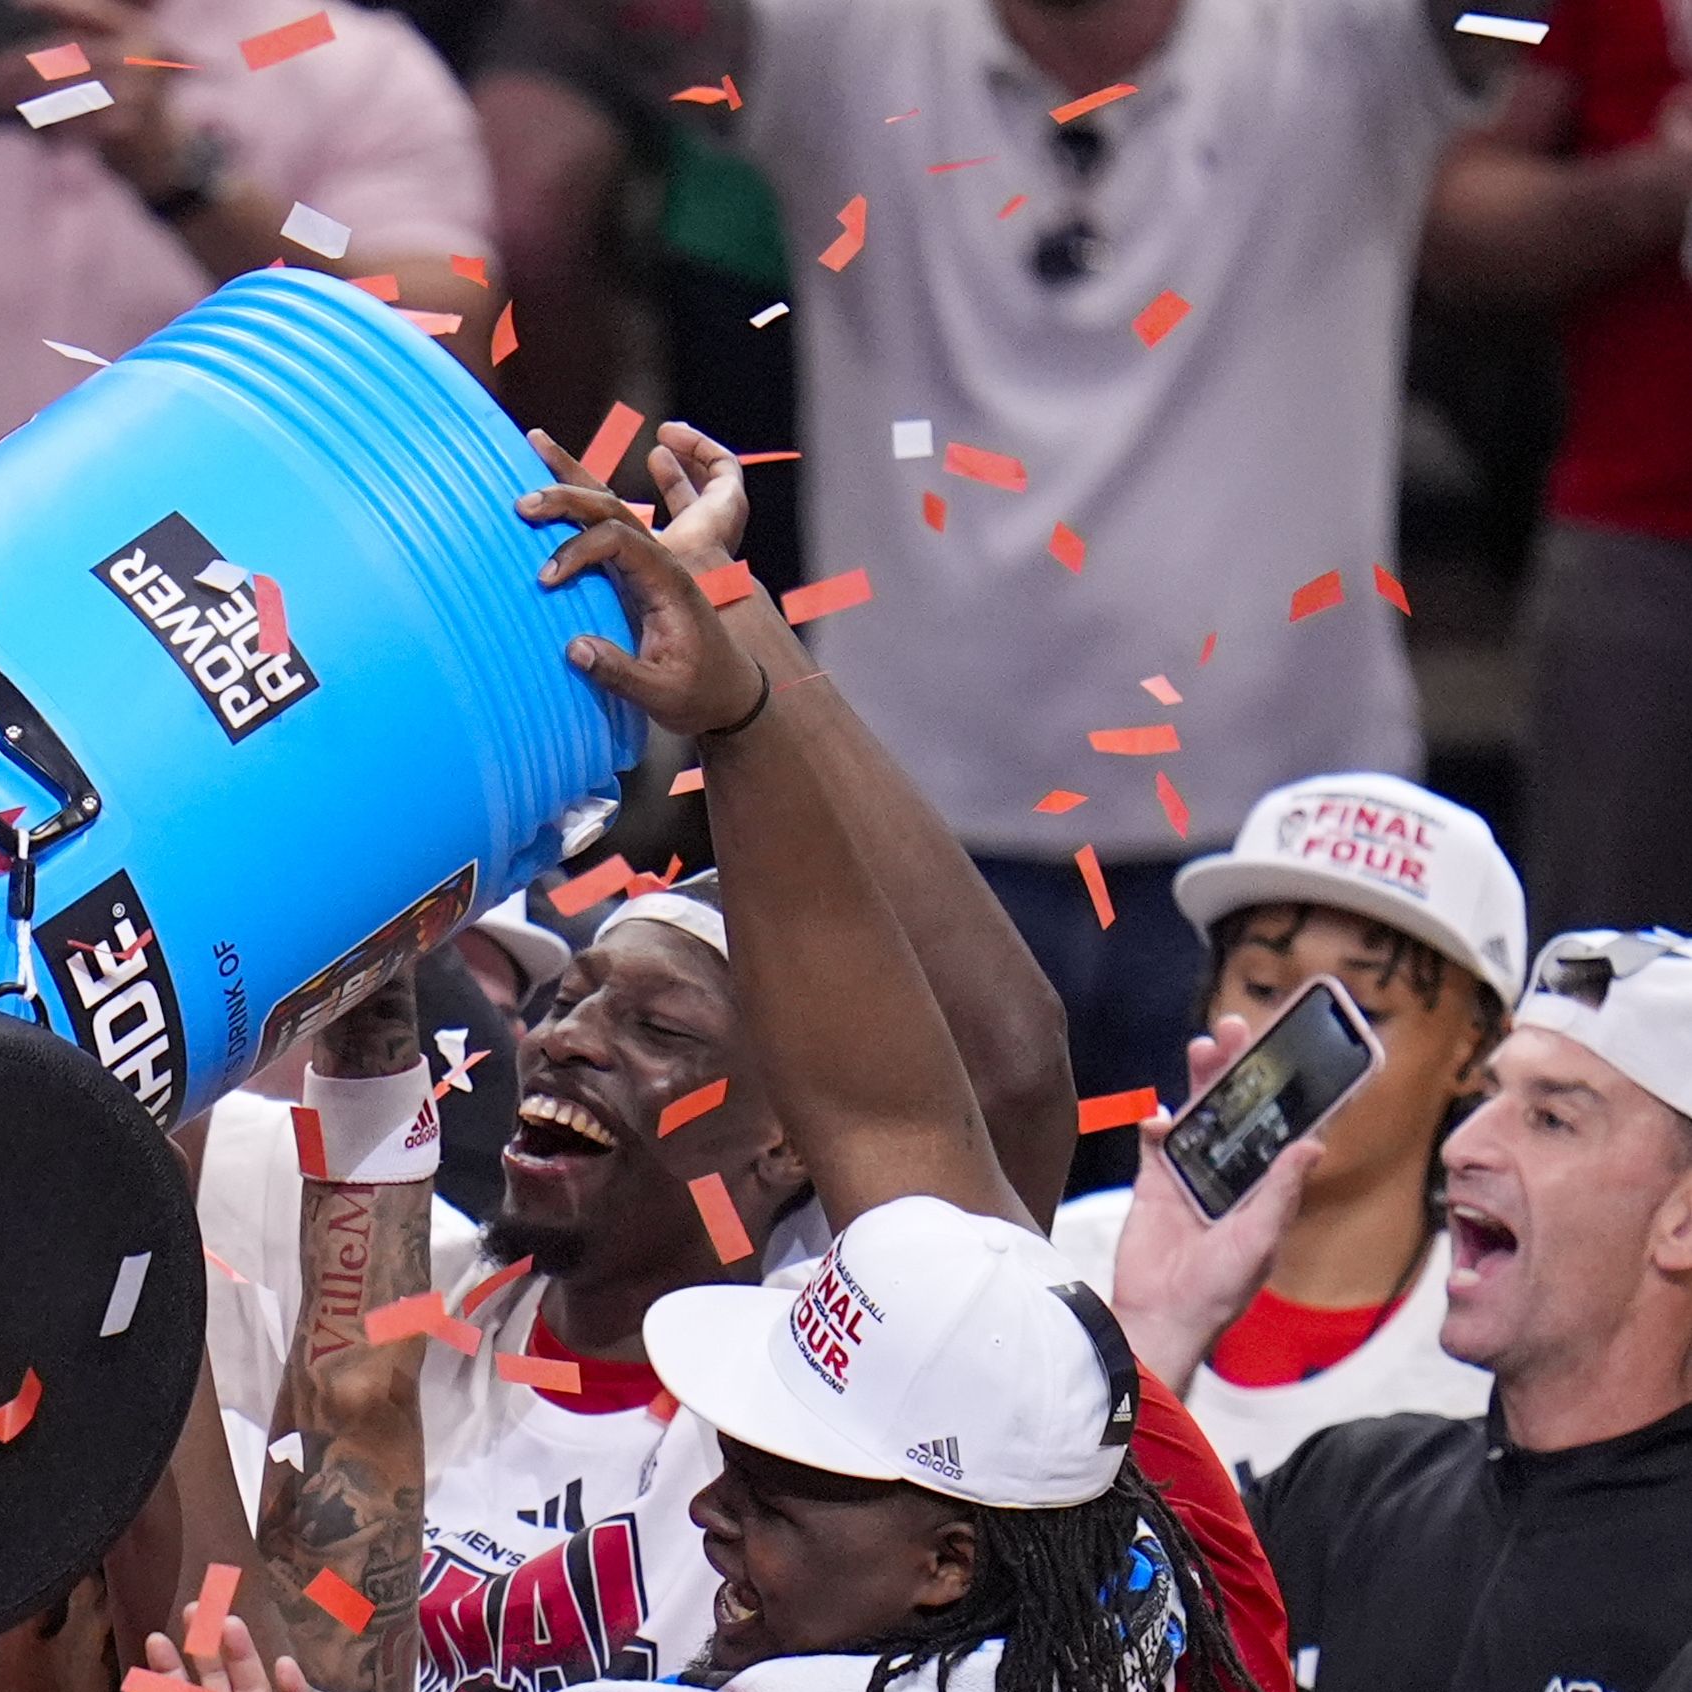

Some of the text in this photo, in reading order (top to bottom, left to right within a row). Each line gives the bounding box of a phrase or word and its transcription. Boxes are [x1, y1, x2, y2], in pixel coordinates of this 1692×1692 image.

[109, 547, 269, 729] POWER
[1315, 802, 1433, 851] FINAL
[1302, 838, 1427, 884] FOUR
[213, 940, 240, 978] OF
[223, 978, 250, 1054] DRINK
[404, 1123, 439, 1149] adidas
[835, 1257, 887, 1324] BASKETBALL
[905, 1446, 965, 1482] adidas
